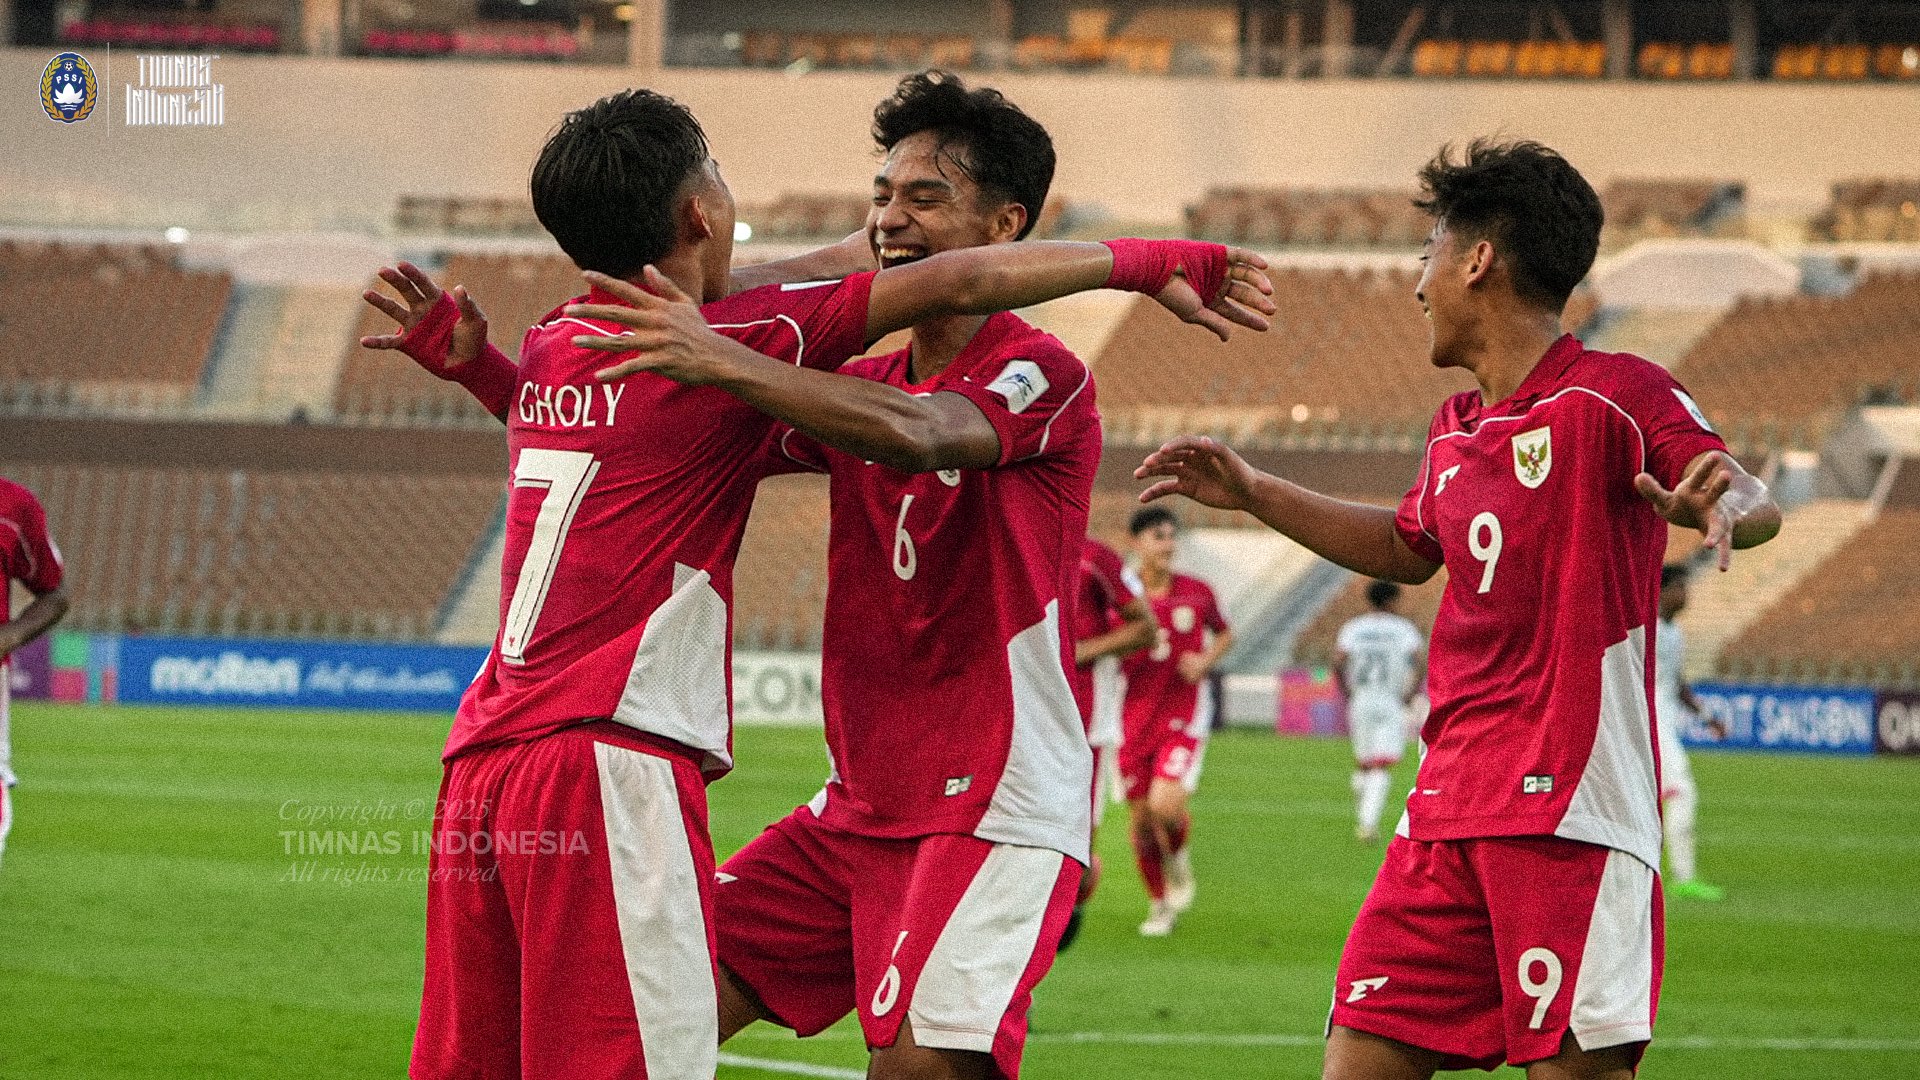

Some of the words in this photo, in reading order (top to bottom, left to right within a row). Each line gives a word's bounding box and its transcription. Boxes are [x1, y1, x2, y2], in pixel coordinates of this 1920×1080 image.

[518, 380, 626, 427] GHOLY
[499, 448, 601, 665] 7
[893, 495, 917, 581] 6
[1468, 511, 1503, 594] 9
[871, 930, 909, 1017] 6
[1517, 947, 1562, 1029] 9
